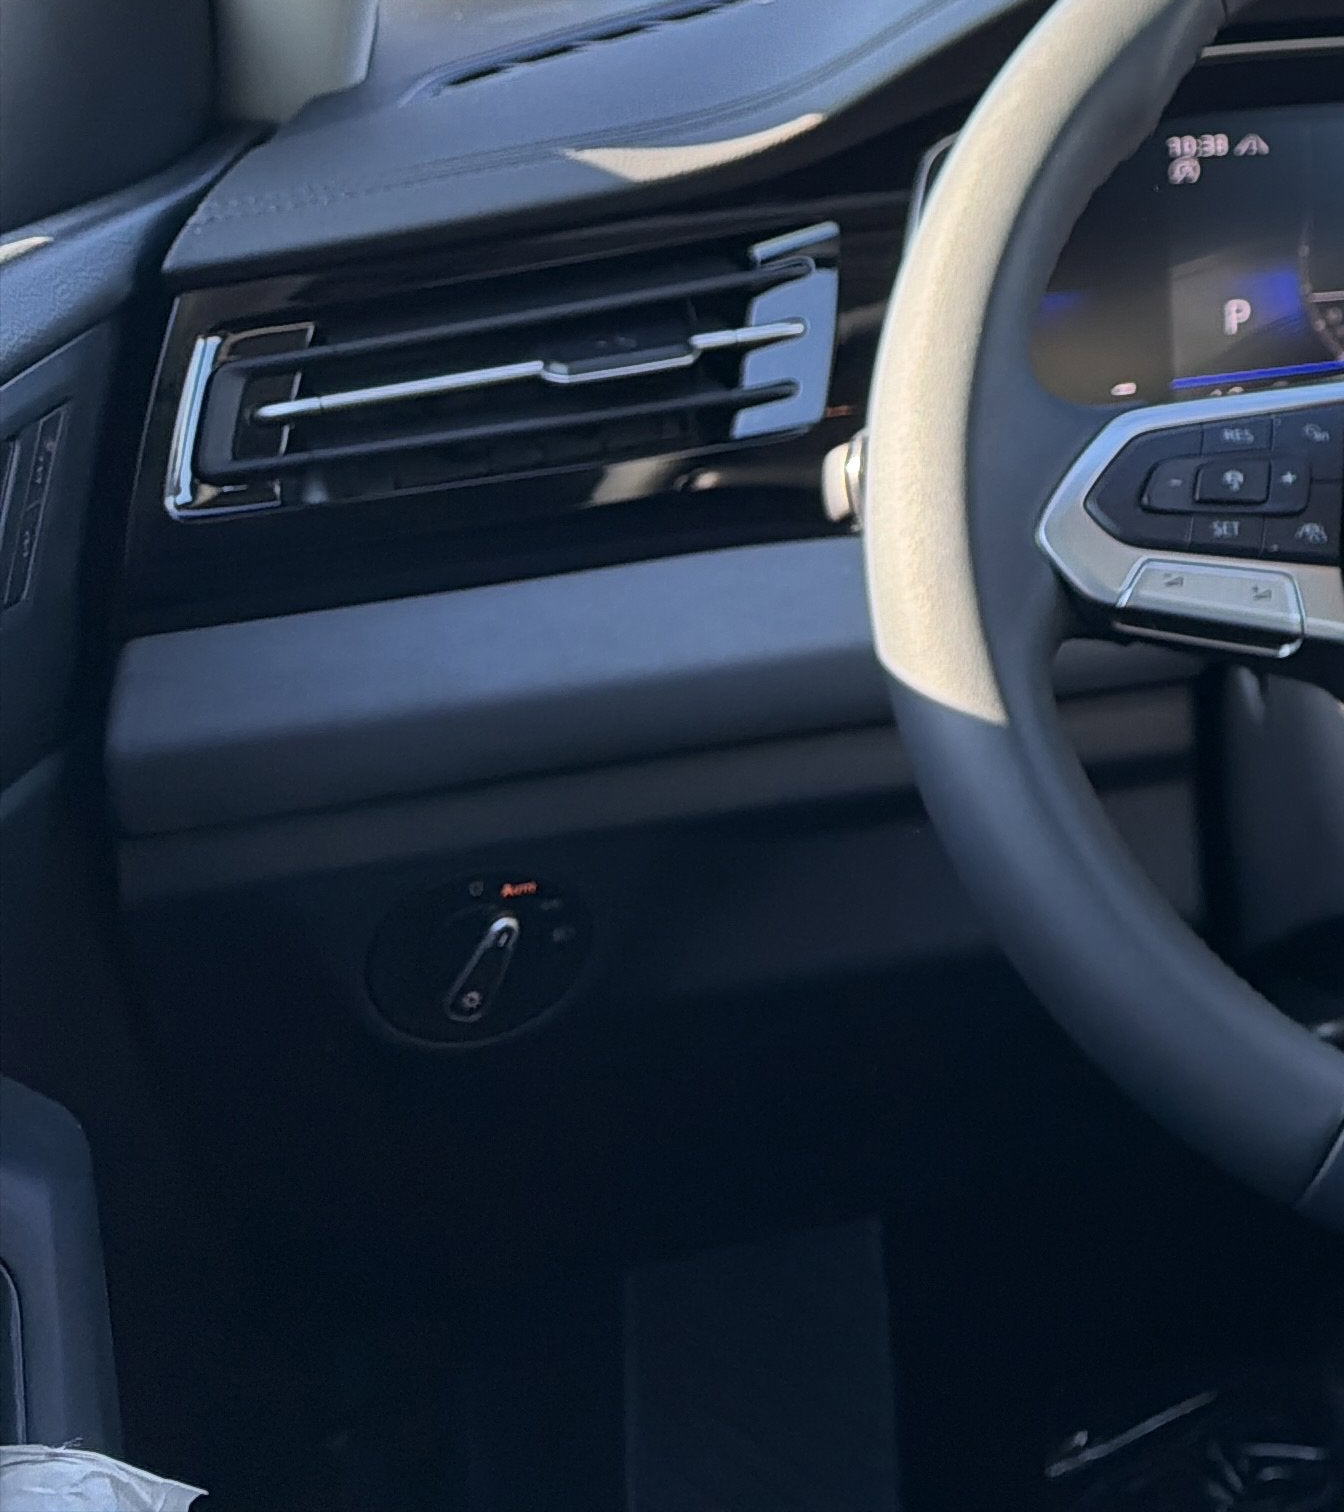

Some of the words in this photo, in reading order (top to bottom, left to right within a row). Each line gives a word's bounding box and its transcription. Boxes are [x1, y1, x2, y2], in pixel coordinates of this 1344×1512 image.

[1223, 297, 1252, 336] P
[1223, 427, 1255, 444] RES
[1211, 519, 1241, 539] SET
